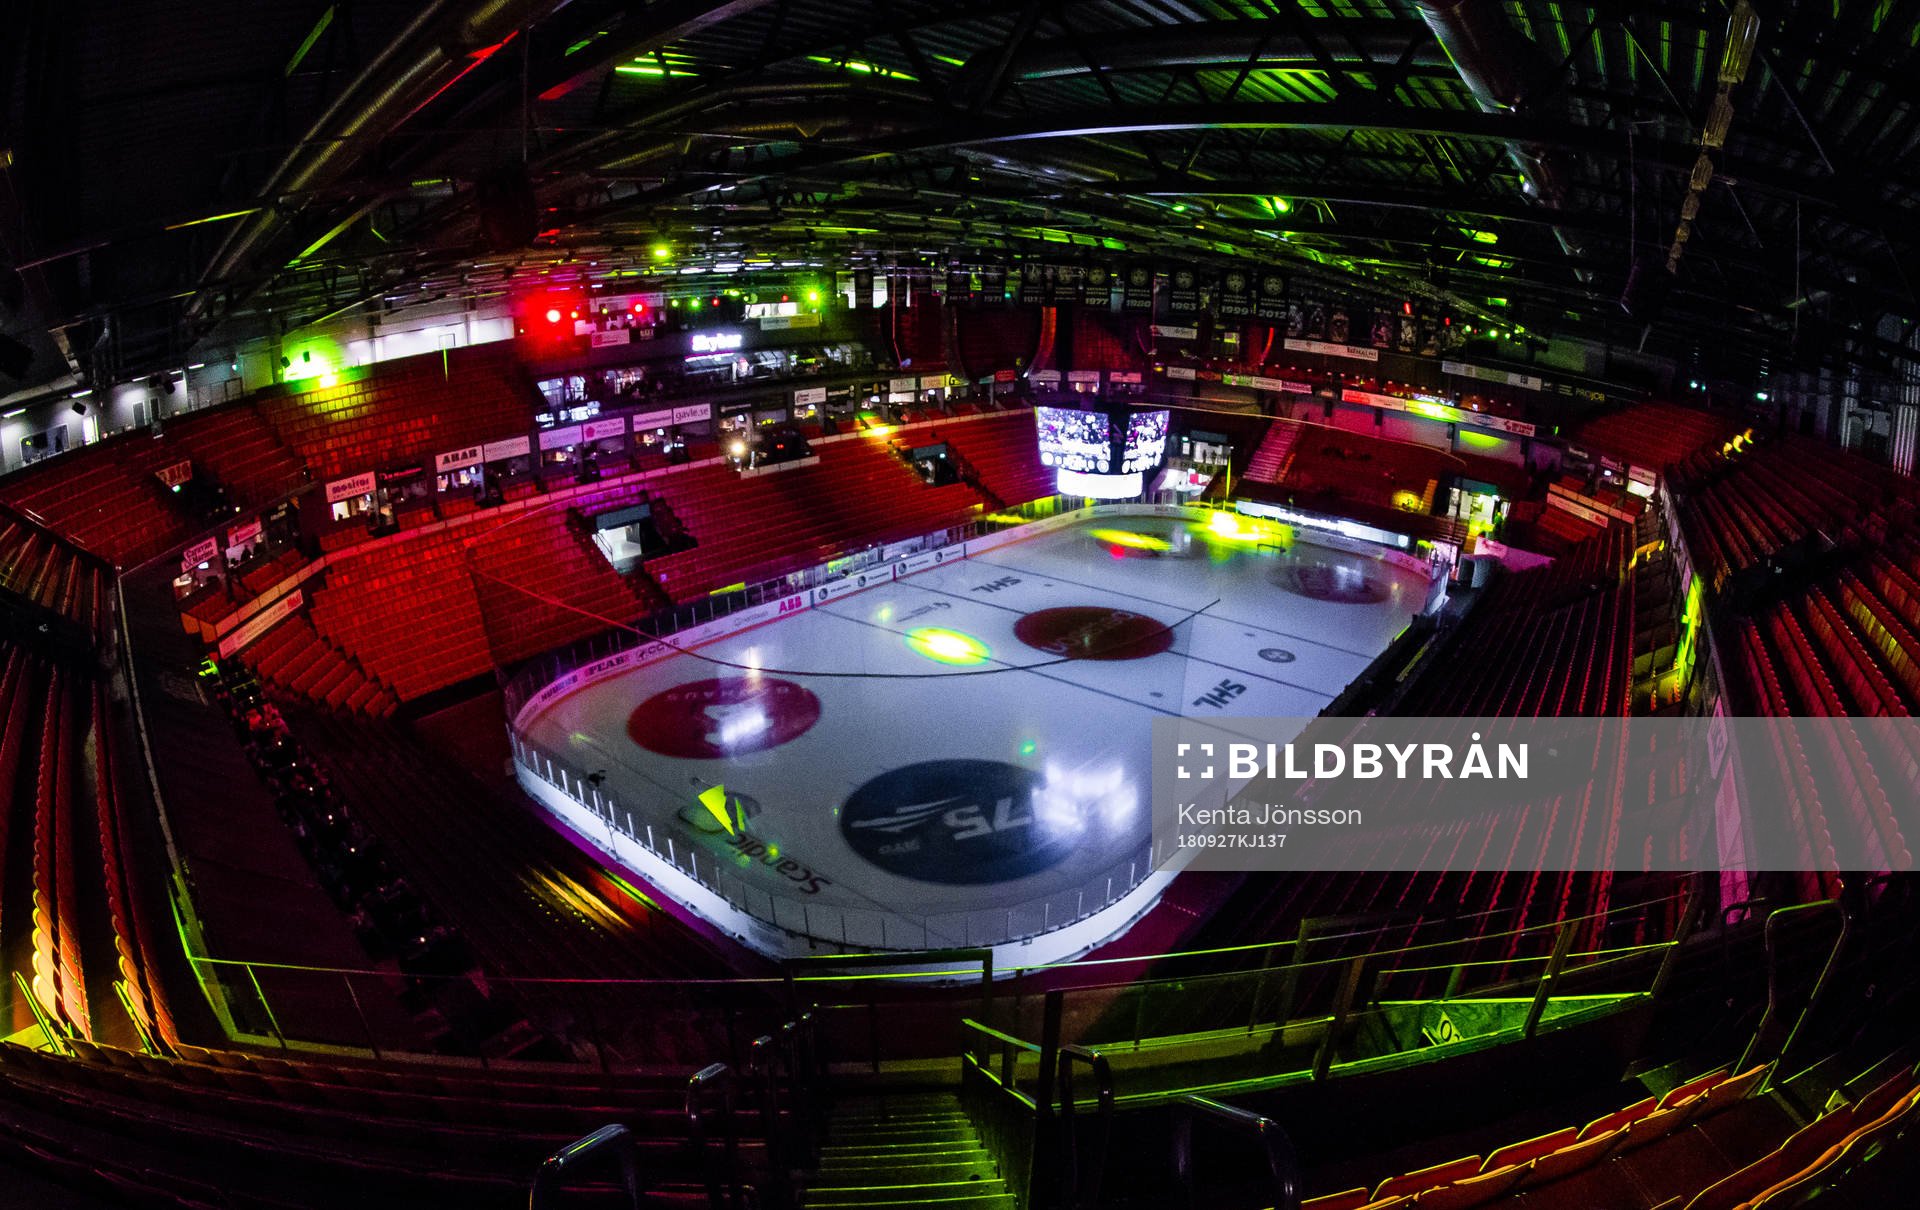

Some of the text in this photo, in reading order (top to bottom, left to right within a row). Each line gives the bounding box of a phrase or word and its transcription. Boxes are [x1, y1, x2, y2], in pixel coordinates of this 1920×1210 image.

[1221, 305, 1249, 315] 1999
[1258, 309, 1287, 320] 2012
[971, 576, 1021, 592] SHL
[778, 595, 802, 614] ABB
[1192, 679, 1247, 708] SHL
[942, 798, 1032, 841] 75
[727, 832, 831, 895] Scandic
